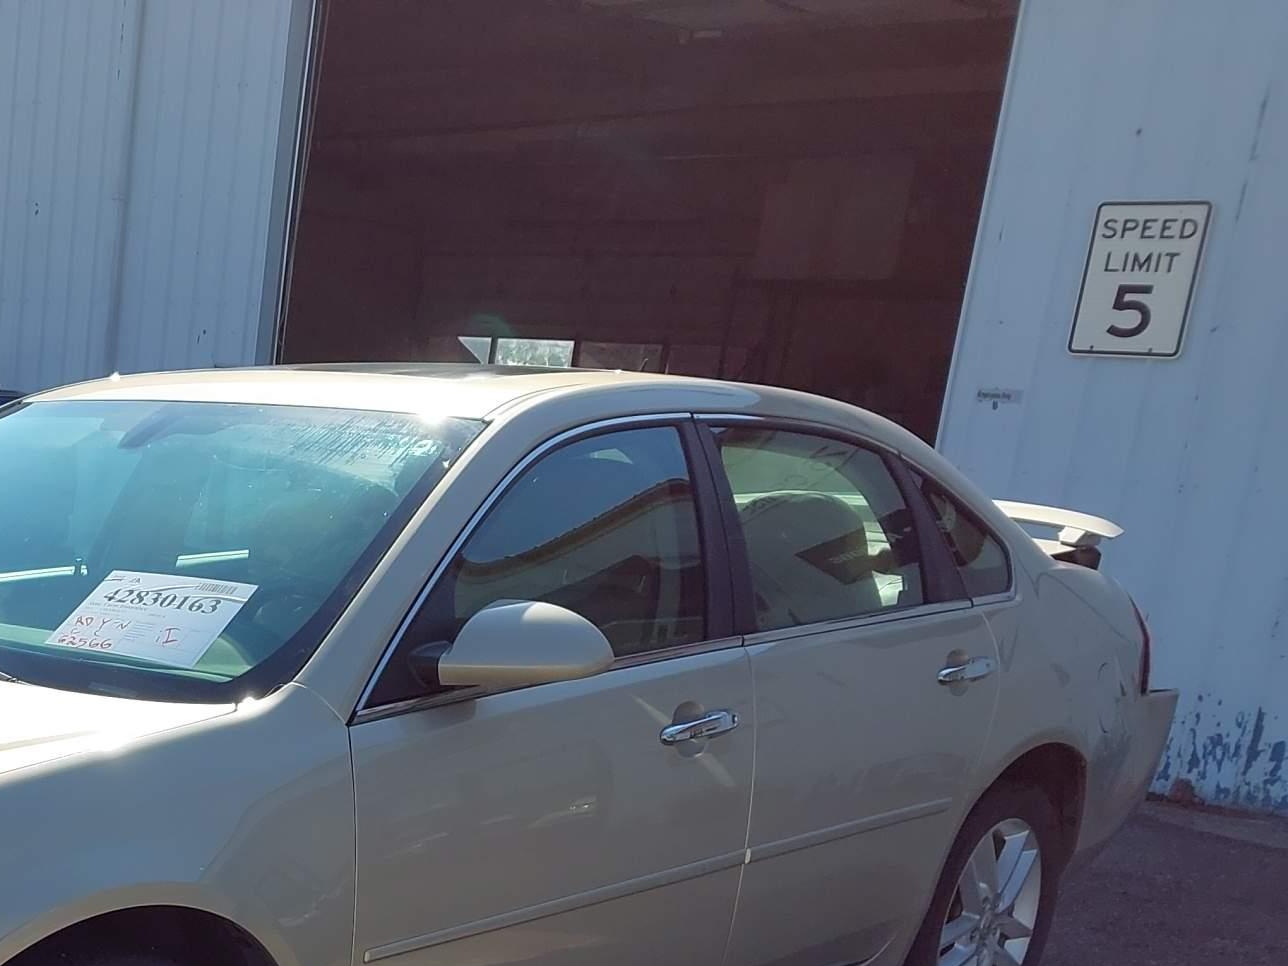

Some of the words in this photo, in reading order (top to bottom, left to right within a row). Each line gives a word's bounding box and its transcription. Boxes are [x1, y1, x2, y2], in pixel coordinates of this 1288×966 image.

[1101, 218, 1198, 239] SPEED
[1104, 252, 1180, 273] LIMIT
[1106, 283, 1154, 338] 5
[103, 588, 222, 614] 42830163
